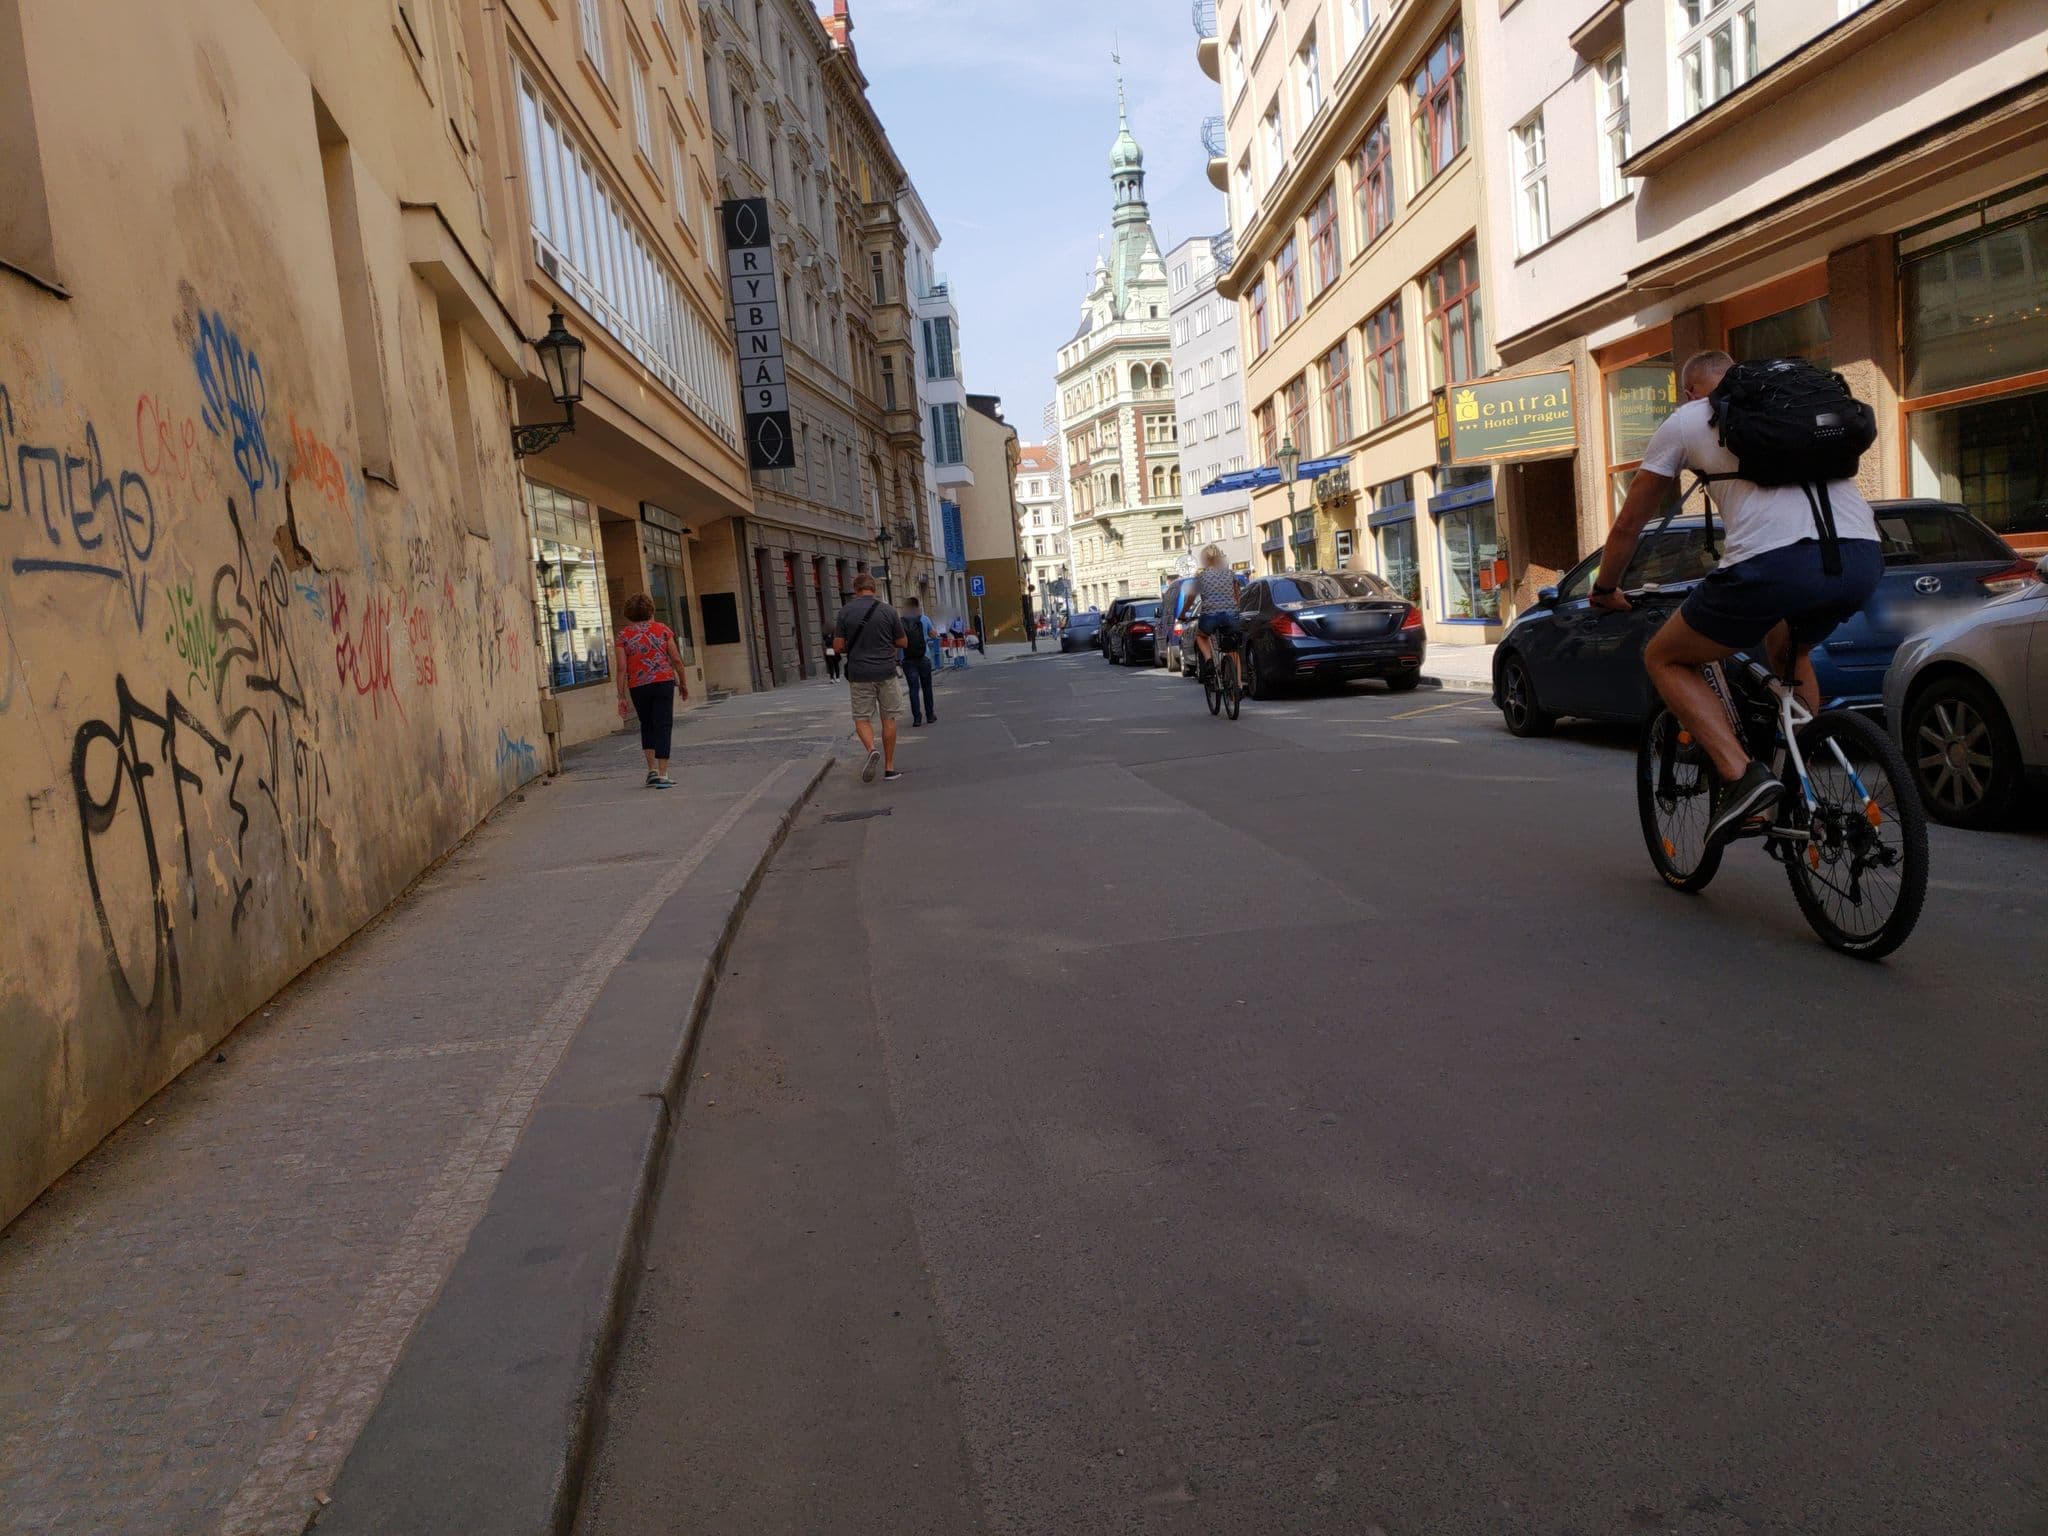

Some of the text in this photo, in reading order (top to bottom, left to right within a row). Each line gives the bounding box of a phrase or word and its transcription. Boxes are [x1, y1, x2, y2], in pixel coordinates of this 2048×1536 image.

[1484, 408, 1570, 430] Hotel Prague
[973, 578, 981, 590] P
